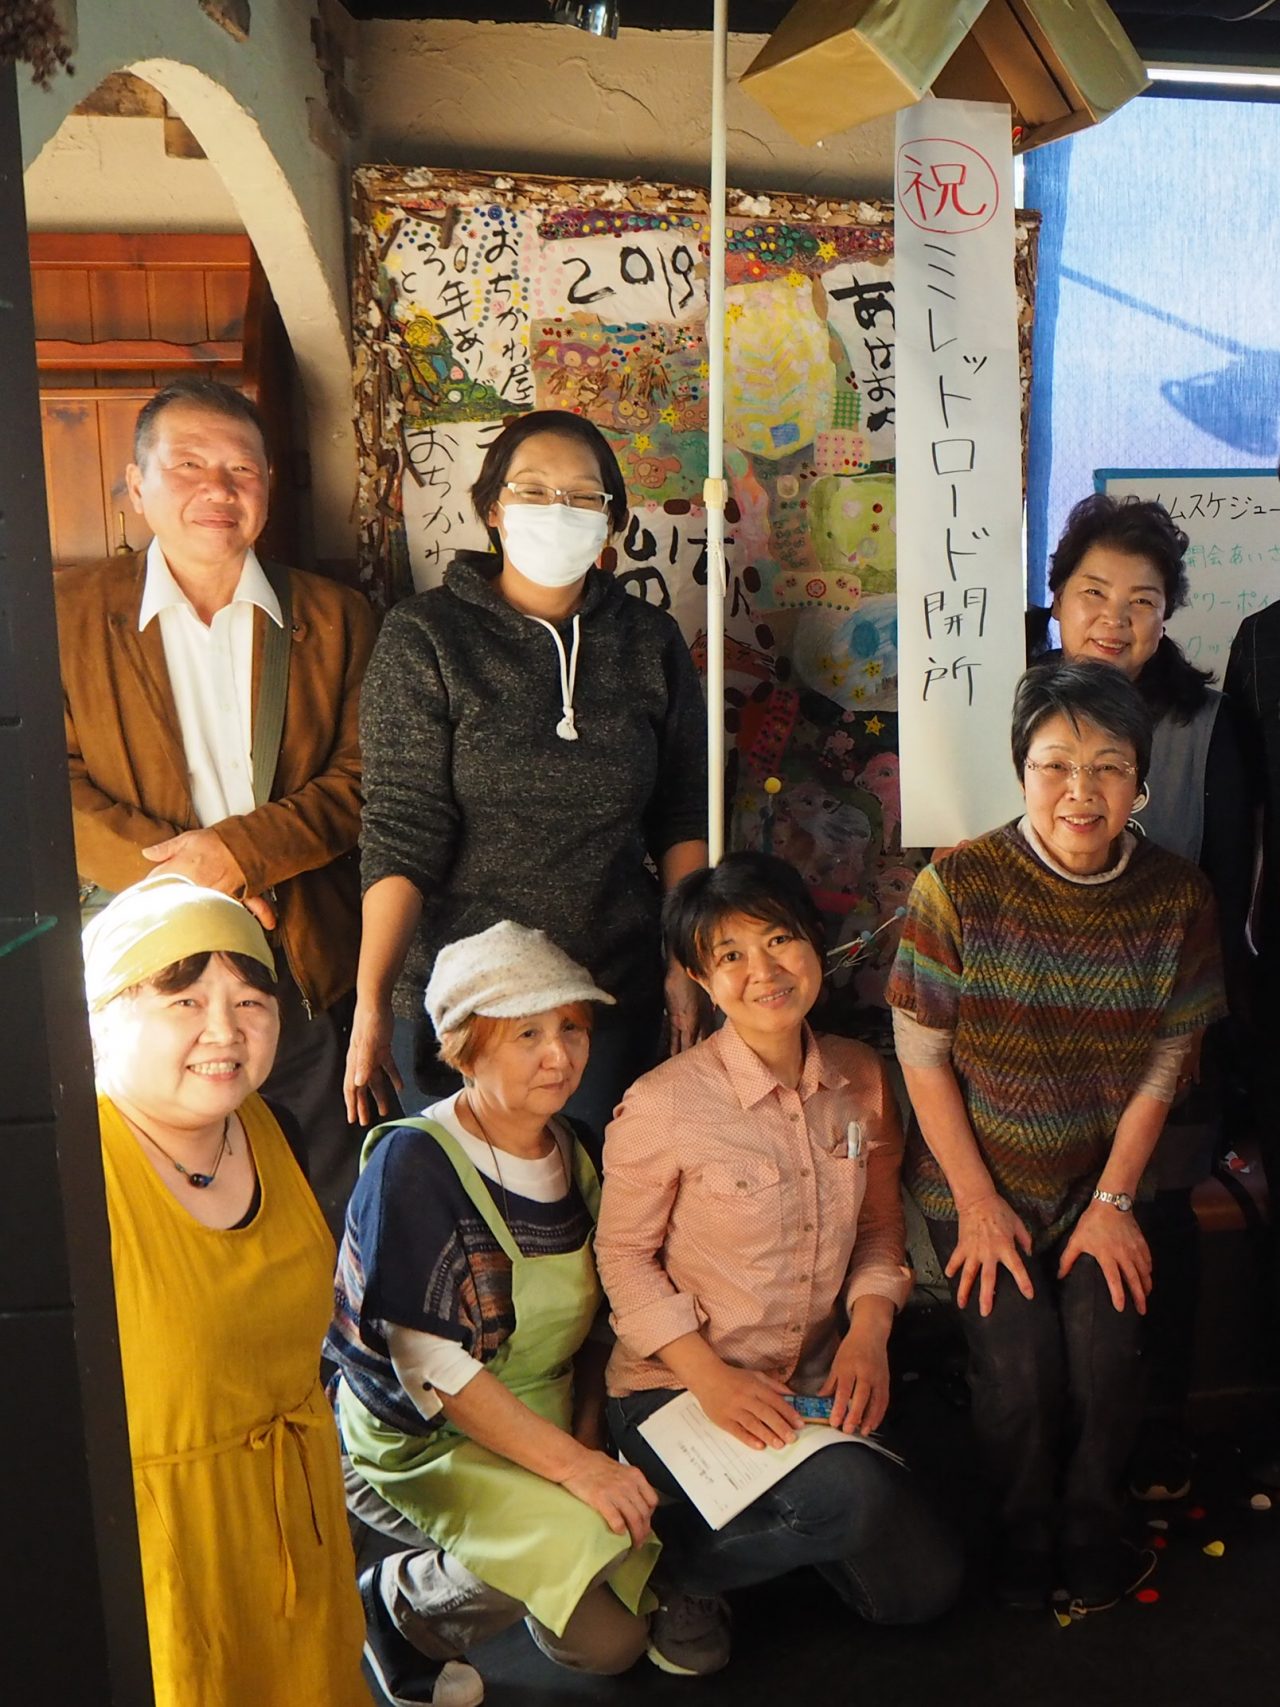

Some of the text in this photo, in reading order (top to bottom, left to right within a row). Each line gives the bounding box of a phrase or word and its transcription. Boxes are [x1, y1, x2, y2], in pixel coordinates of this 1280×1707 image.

[903, 153, 988, 218] 祝
[562, 245, 695, 319] 2019
[922, 243, 990, 707] ミレットロード開所
